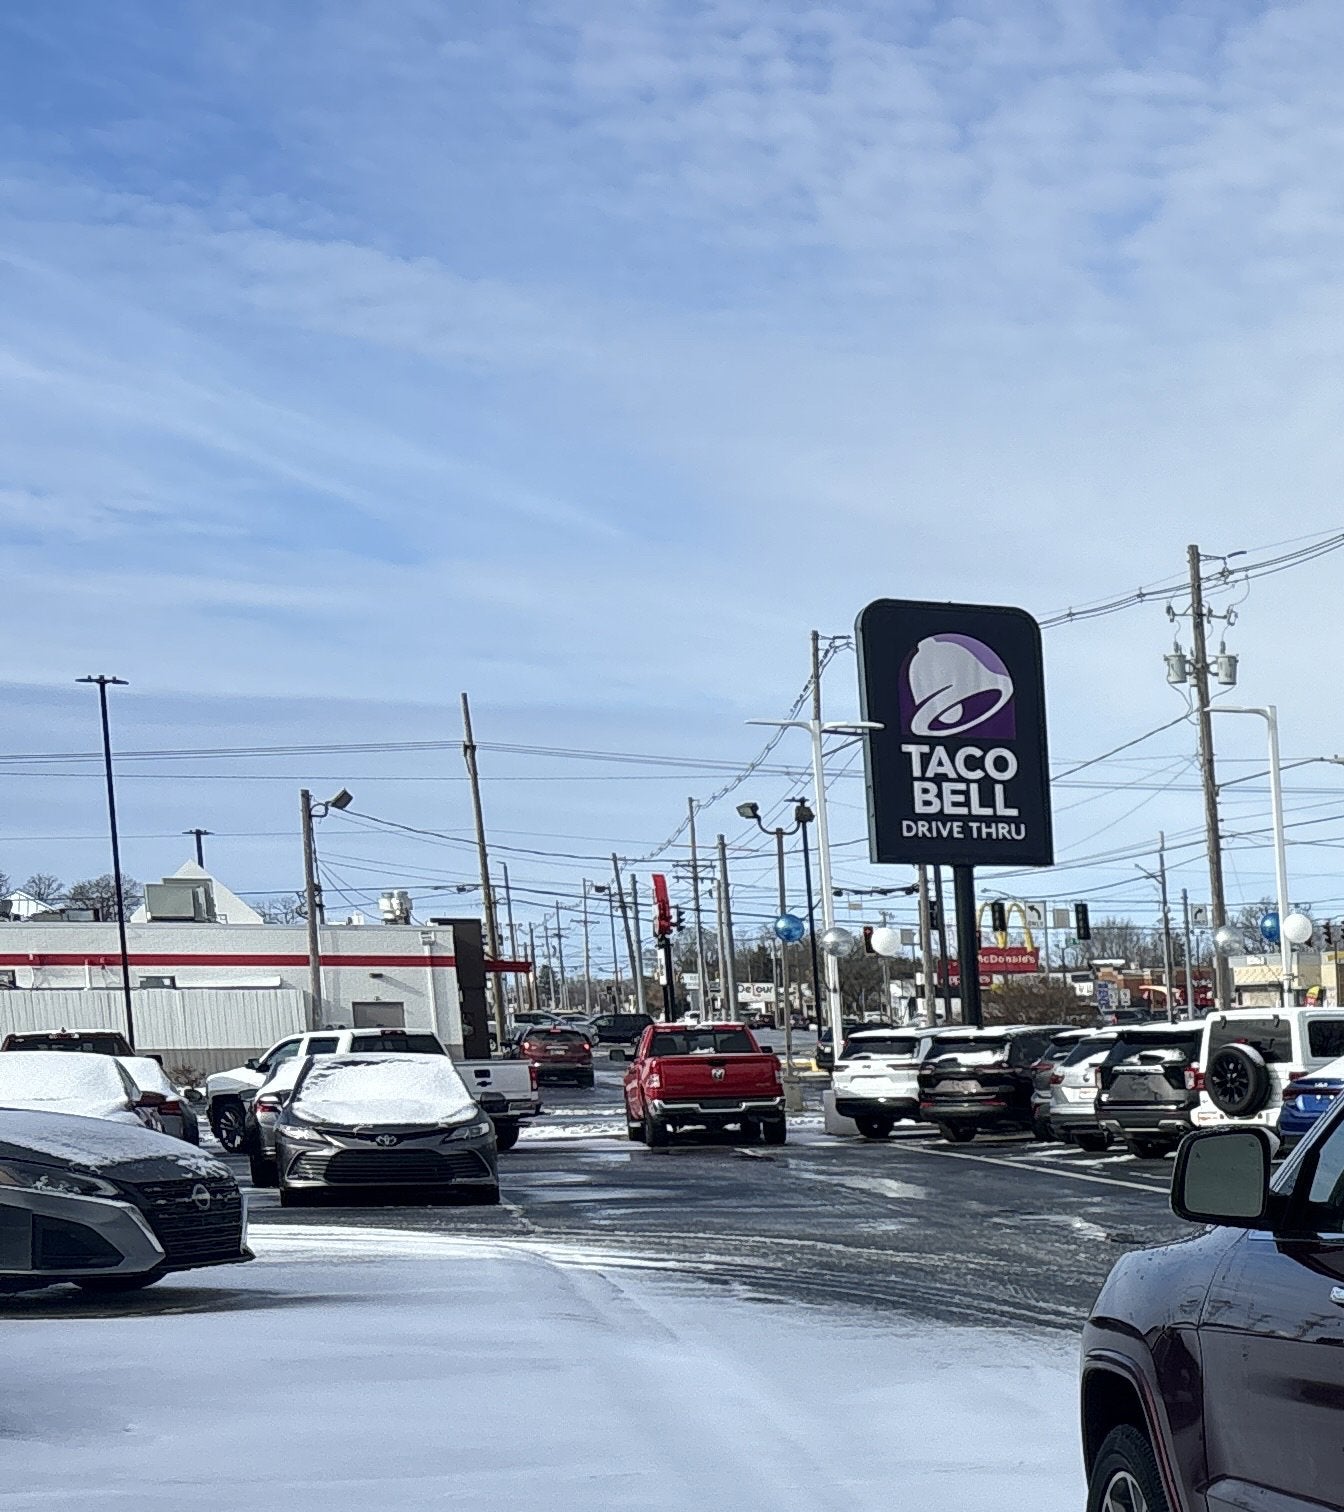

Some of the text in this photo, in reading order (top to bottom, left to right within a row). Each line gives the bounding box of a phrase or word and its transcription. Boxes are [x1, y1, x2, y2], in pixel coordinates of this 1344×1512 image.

[901, 744, 1018, 781] TACO
[913, 781, 1019, 816] BELL
[902, 820, 1026, 840] DRIVE THRU
